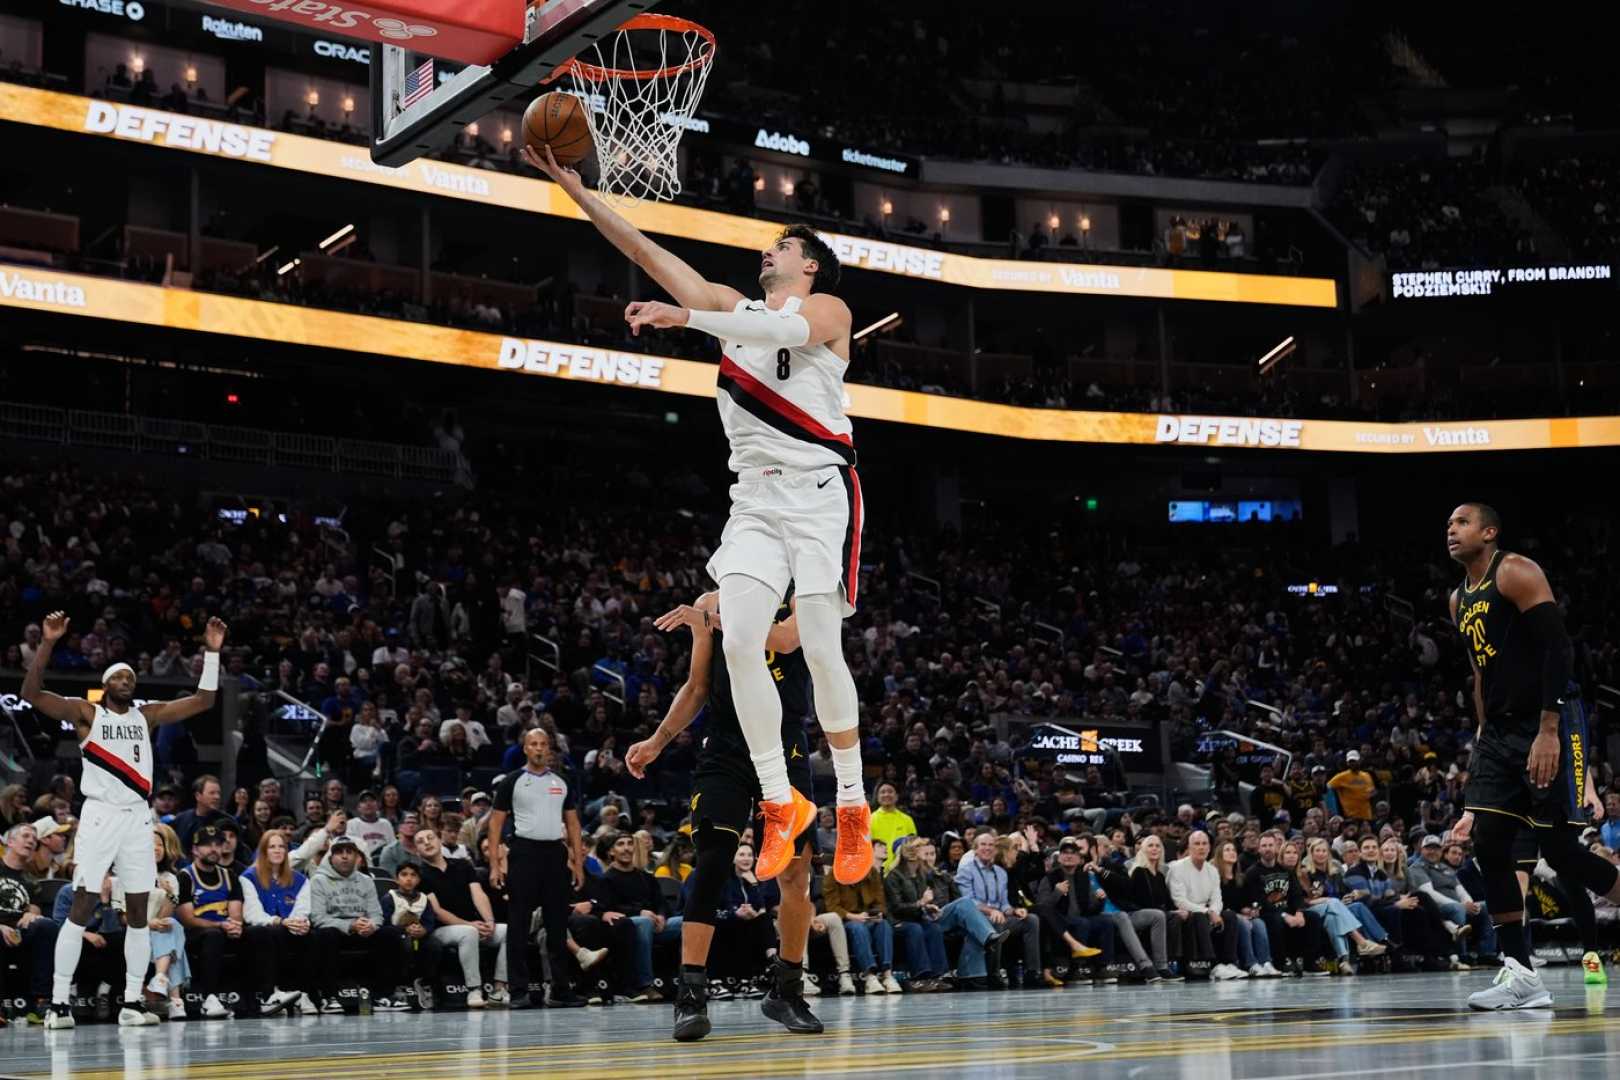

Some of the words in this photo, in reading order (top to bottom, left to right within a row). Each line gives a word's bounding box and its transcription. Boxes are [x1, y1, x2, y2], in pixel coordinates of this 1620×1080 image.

[202, 15, 263, 41] Rakuten
[313, 40, 371, 65] ORAC
[84, 101, 274, 161] DEFENSE
[754, 128, 810, 156] Adobe
[842, 148, 907, 173] ticketmaster
[419, 163, 489, 196] Vanta
[0, 271, 86, 307] Vanta
[1056, 265, 1121, 289] Vanta
[1392, 271, 1453, 286] STEPHEN
[1508, 268, 1547, 282] FROM
[1549, 265, 1611, 280] BRANDIN
[498, 336, 666, 388] DEFENSE
[776, 347, 790, 380] 8
[1154, 415, 1305, 447] DEFENSE
[1423, 426, 1490, 446] Vanta
[1460, 601, 1490, 633] GOLDEN
[1466, 618, 1486, 652] 20
[101, 725, 144, 741] BLAZERS
[133, 744, 141, 763] 9
[1570, 734, 1584, 809] WARRIORS
